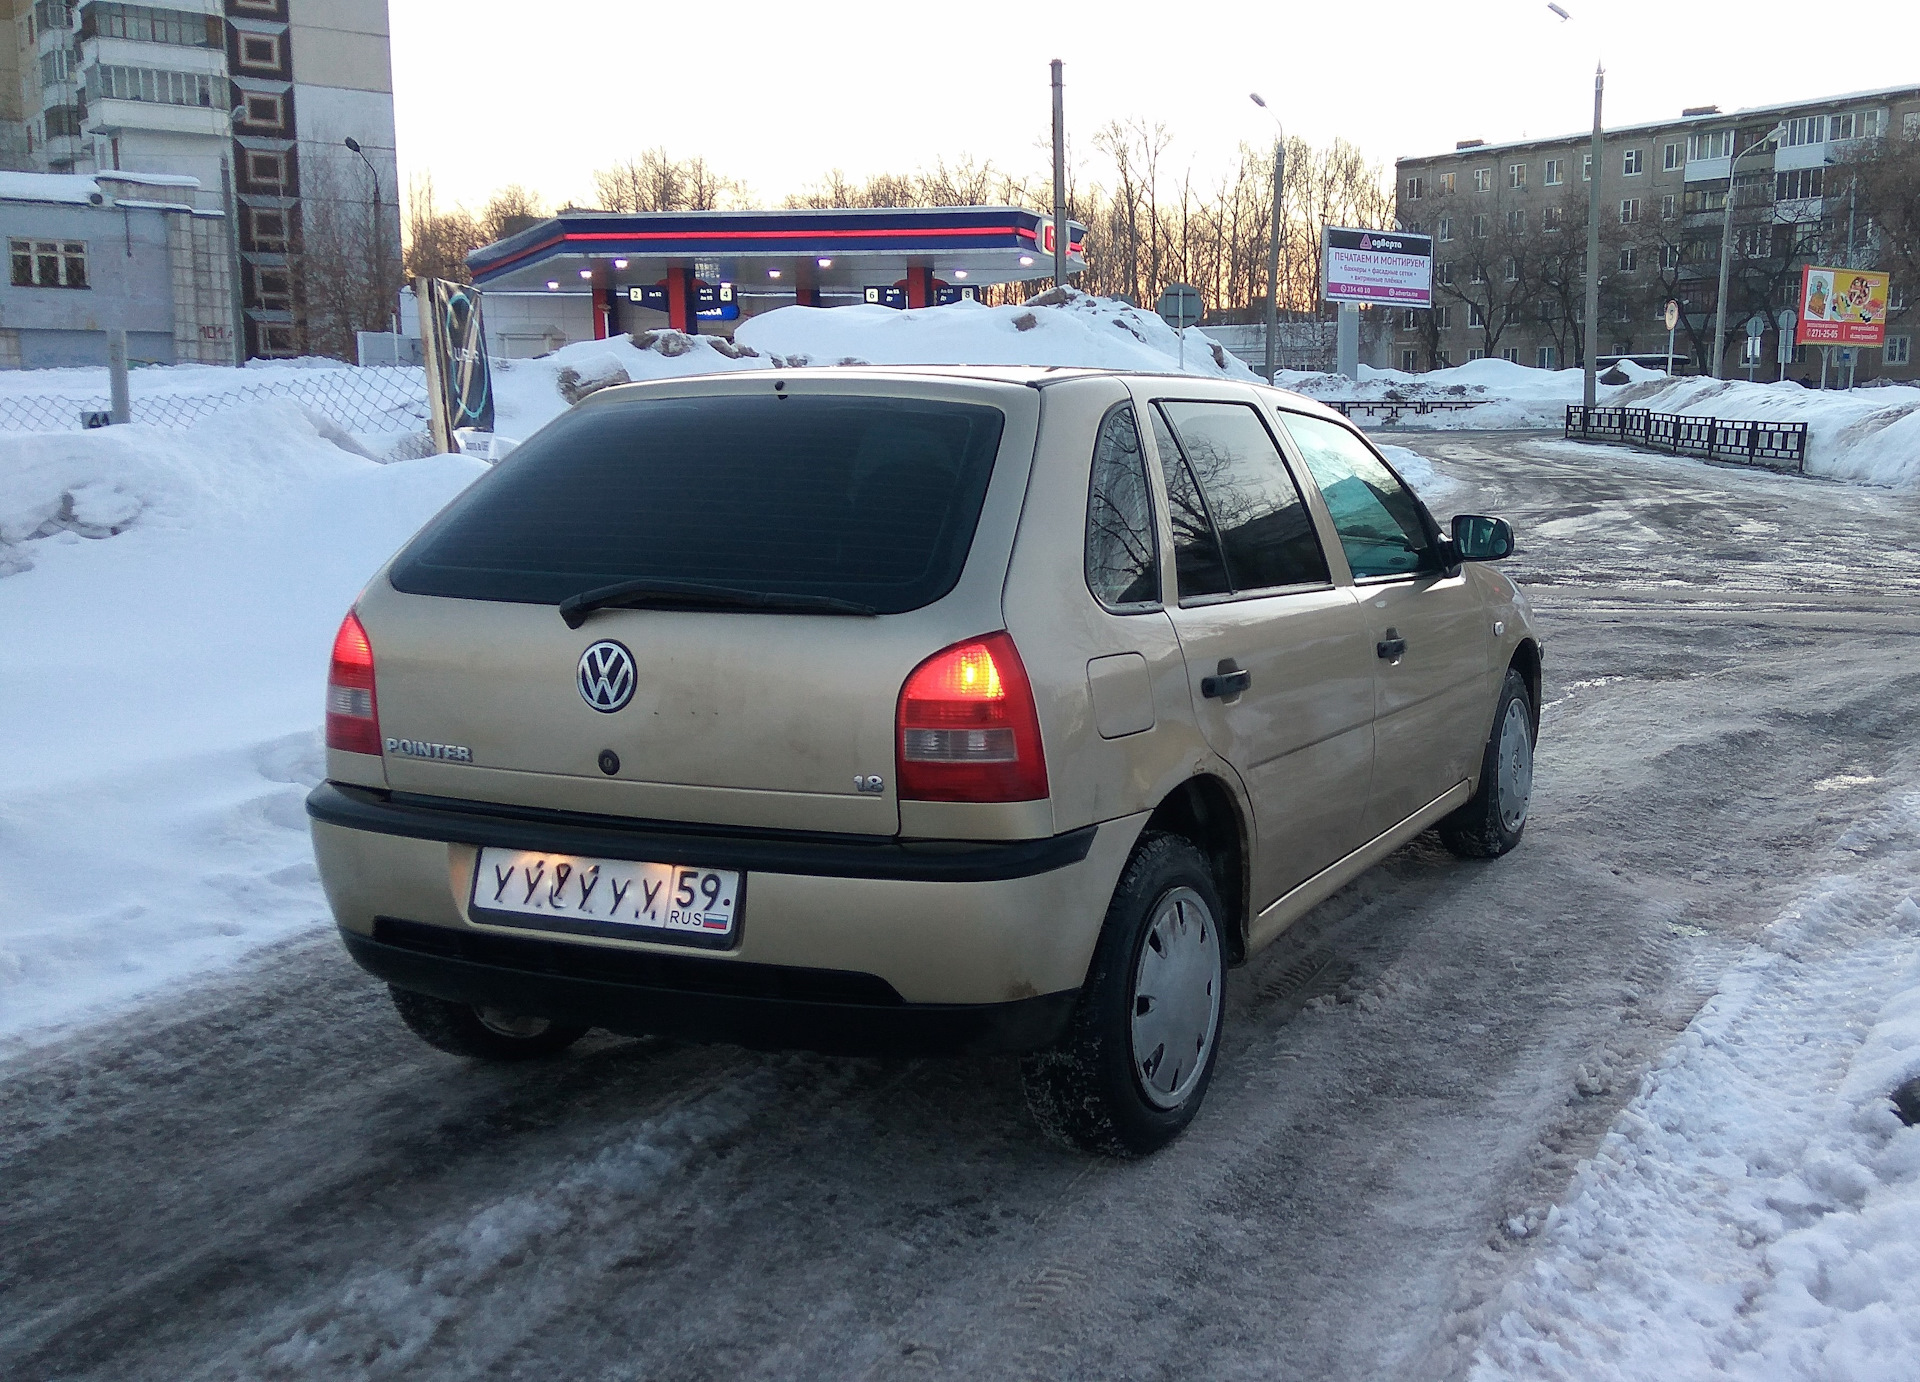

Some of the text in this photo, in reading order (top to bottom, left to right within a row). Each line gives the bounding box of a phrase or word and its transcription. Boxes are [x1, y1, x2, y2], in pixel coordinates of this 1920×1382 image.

[1334, 251, 1425, 268] ПЕЧАТАЕМ И МОНТИРУЕМ
[1371, 267, 1399, 277] фасадные
[1399, 269, 1413, 277] сетки
[385, 736, 474, 762] POINTER
[669, 910, 702, 926] RUS
